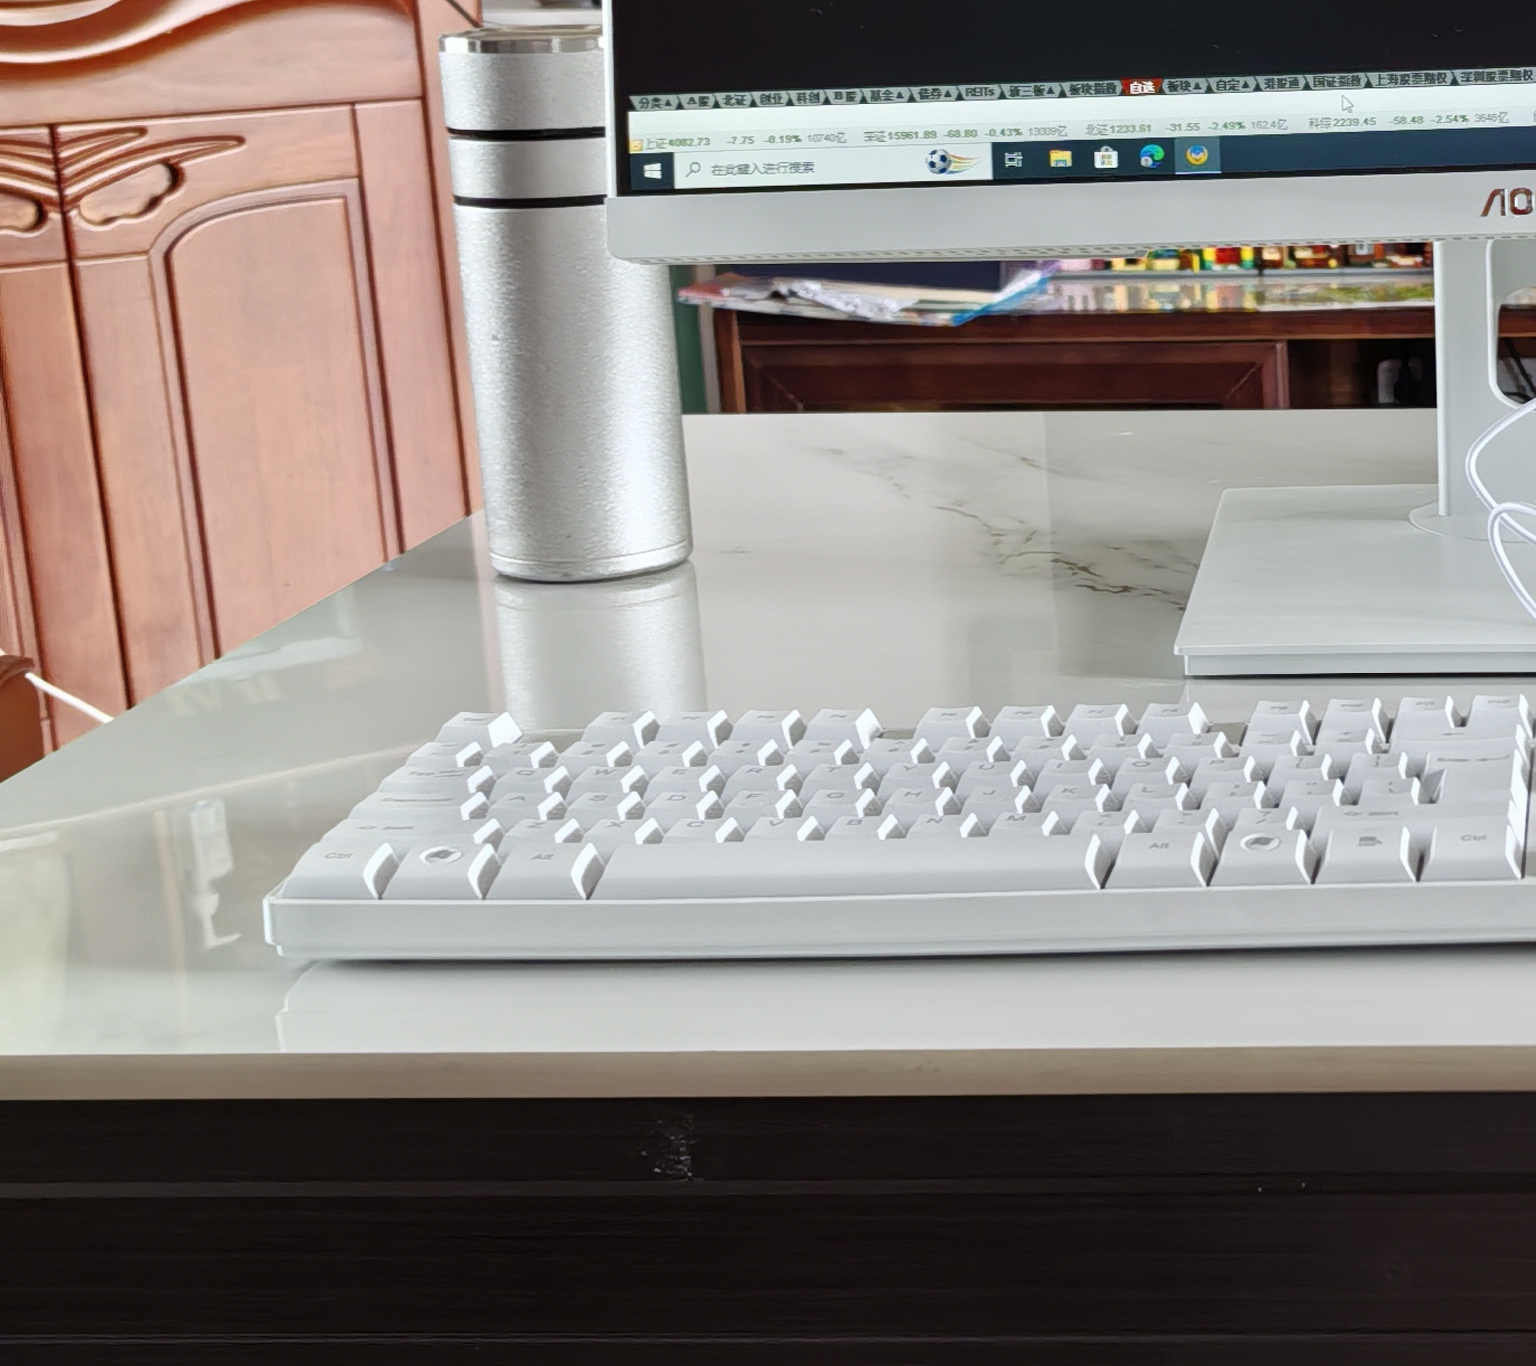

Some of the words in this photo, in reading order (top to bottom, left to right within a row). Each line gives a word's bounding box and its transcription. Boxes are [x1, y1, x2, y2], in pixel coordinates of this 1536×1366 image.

[965, 87, 995, 97] REITs
[1130, 81, 1155, 94] 自选
[1168, 80, 1191, 92] 板块
[1216, 79, 1241, 91] 自定
[711, 162, 815, 177] 在此键入进行搜索
